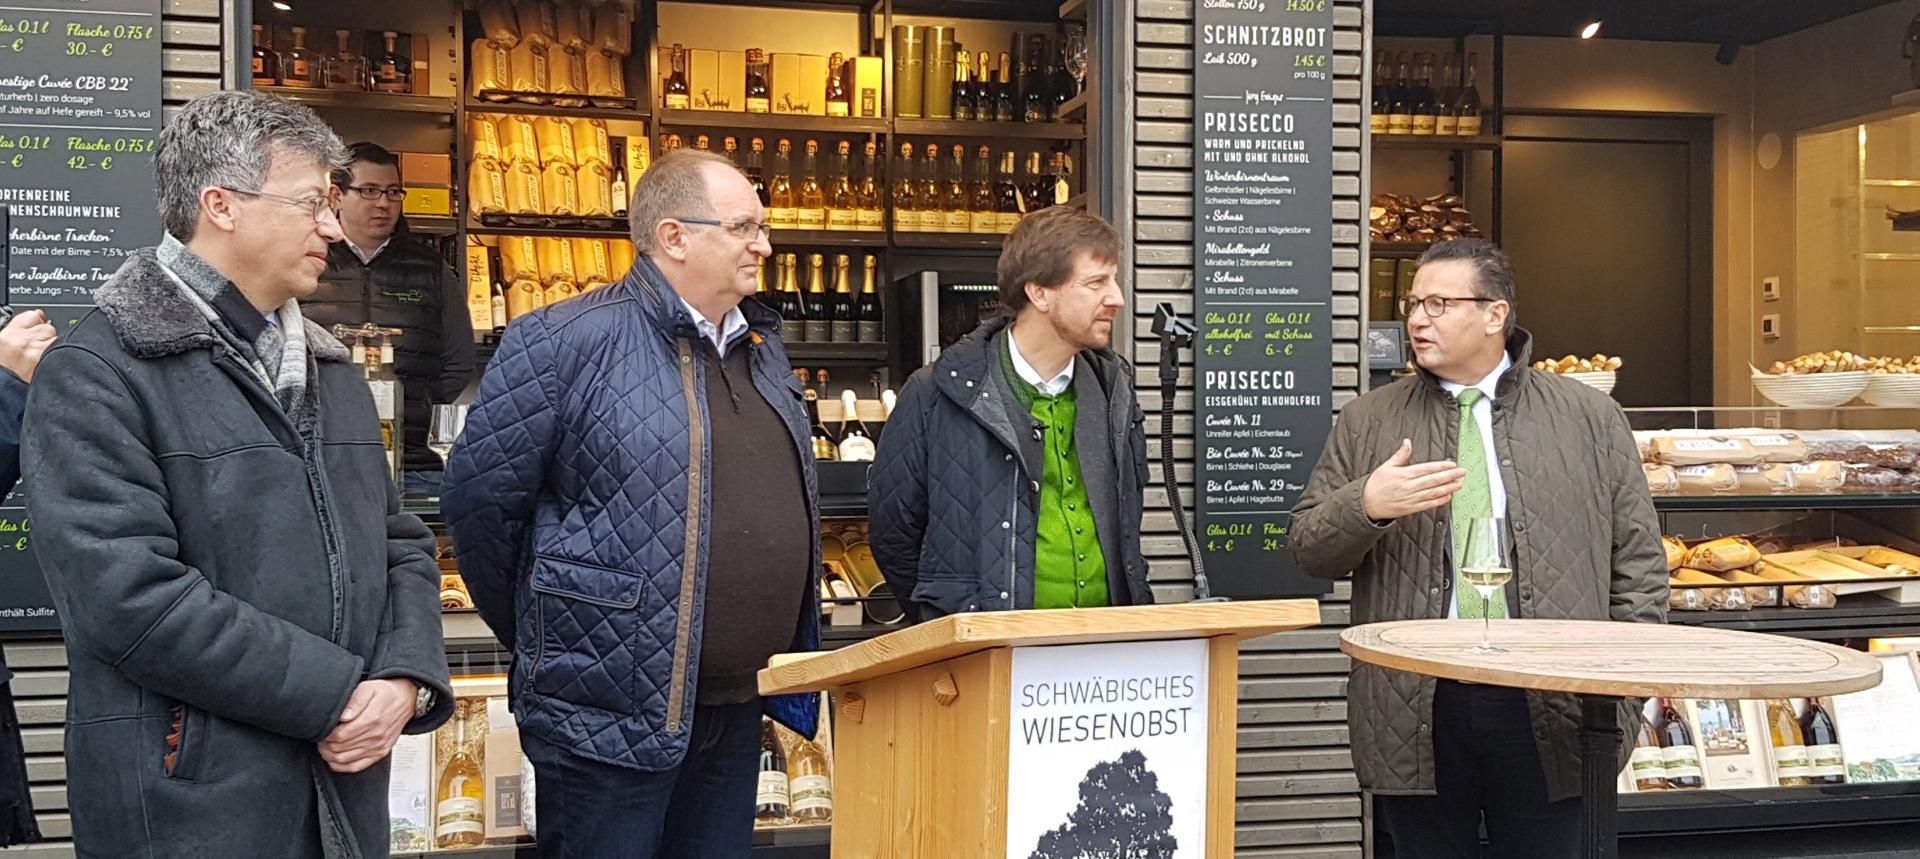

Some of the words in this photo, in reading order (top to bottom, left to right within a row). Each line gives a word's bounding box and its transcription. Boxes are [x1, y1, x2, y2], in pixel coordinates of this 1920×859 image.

[1316, 0, 1325, 12] €
[18, 20, 38, 34] 0.1
[67, 23, 110, 37] Flasche
[114, 25, 143, 39] 0.75
[1204, 24, 1326, 47] SCHNITZBROT
[12, 38, 23, 51] €
[102, 43, 112, 56] €
[1203, 52, 1224, 64] Laib
[1227, 52, 1250, 65] 500
[1294, 55, 1314, 66] 1.45
[1316, 55, 1325, 67] €
[38, 75, 73, 88] Cuvée
[75, 76, 106, 90] CBB
[61, 94, 94, 105] dosage
[8, 106, 33, 114] Jahre
[35, 106, 50, 115] auf
[52, 107, 73, 116] Hefe
[75, 108, 103, 118] gereift
[114, 109, 136, 118] 9,5%
[137, 110, 151, 118] vol
[1205, 112, 1293, 133] PRISECCO
[19, 136, 39, 149] 0.1
[68, 137, 111, 151] Flasche
[115, 139, 144, 152] 0.75
[1204, 139, 1231, 149] WARM
[1234, 139, 1252, 149] UND
[1255, 139, 1304, 150] PRICKELND
[12, 154, 23, 167] €
[101, 157, 112, 169] €
[1204, 152, 1220, 162] MIT
[1224, 152, 1242, 162] UND
[1245, 152, 1268, 163] OHNE
[1272, 153, 1309, 163] ALKOHOL
[1204, 169, 1290, 182] Winterbirnentraum
[1249, 186, 1292, 195] Nägelesbirne
[1205, 197, 1239, 205] Schweizer
[1212, 209, 1244, 221] Schuss
[1268, 226, 1311, 235] Nägelesbirne
[11, 246, 32, 255] Date
[34, 247, 49, 255] mit
[51, 247, 66, 255] der
[67, 247, 91, 256] Birne
[102, 248, 123, 257] 7,5%
[1205, 243, 1270, 257] Mirabellengold
[1240, 259, 1293, 267] Zitronenverbene
[27, 267, 87, 283] Jagdbirne
[1213, 271, 1244, 283] Schuss
[33, 286, 62, 296] Jungs
[73, 286, 87, 295] 7%
[1217, 287, 1237, 295] Brand
[1268, 287, 1299, 295] Mirabelle
[1205, 312, 1225, 324] Glas
[1228, 312, 1243, 324] 0.1
[1265, 312, 1285, 324] Glas
[1287, 312, 1303, 324] 0.1
[1205, 328, 1253, 342] alkoholfrei
[1265, 330, 1280, 339] mit
[1282, 328, 1313, 340] Schuss
[1223, 344, 1232, 355] €
[1284, 344, 1293, 355] €
[1206, 371, 1294, 390] PRISECCO
[1205, 395, 1258, 406] EISGEKÜHLT
[1262, 395, 1320, 406] ALKOHOLFREI
[1206, 414, 1231, 426] Cuvée
[1234, 414, 1247, 426] Nr.
[1251, 414, 1261, 426] 11
[1206, 430, 1232, 438] Unreifer
[1233, 429, 1250, 438] Apfel
[1206, 447, 1222, 459] Bio
[1224, 447, 1249, 459] Cuvée
[1252, 447, 1265, 458] Nr.
[1268, 446, 1283, 458] 25
[1206, 463, 1223, 471] Birne
[1259, 462, 1291, 471] Douglasie
[1207, 480, 1222, 492] Bio
[1224, 480, 1250, 492] Cuvée
[1252, 480, 1266, 491] Nr.
[1269, 479, 1284, 491] 29
[1206, 496, 1224, 504] Birne
[1228, 495, 1245, 504] Apfel
[1250, 496, 1284, 504] Hagebutte
[1207, 524, 1227, 536] Glas
[1229, 524, 1245, 535] 0.1
[15, 537, 27, 550] €
[1225, 539, 1233, 551] €
[26, 607, 55, 617] Sulfite
[1021, 675, 1194, 707] SCHWÄBISCHES
[1022, 707, 1192, 745] WIESENOBST
